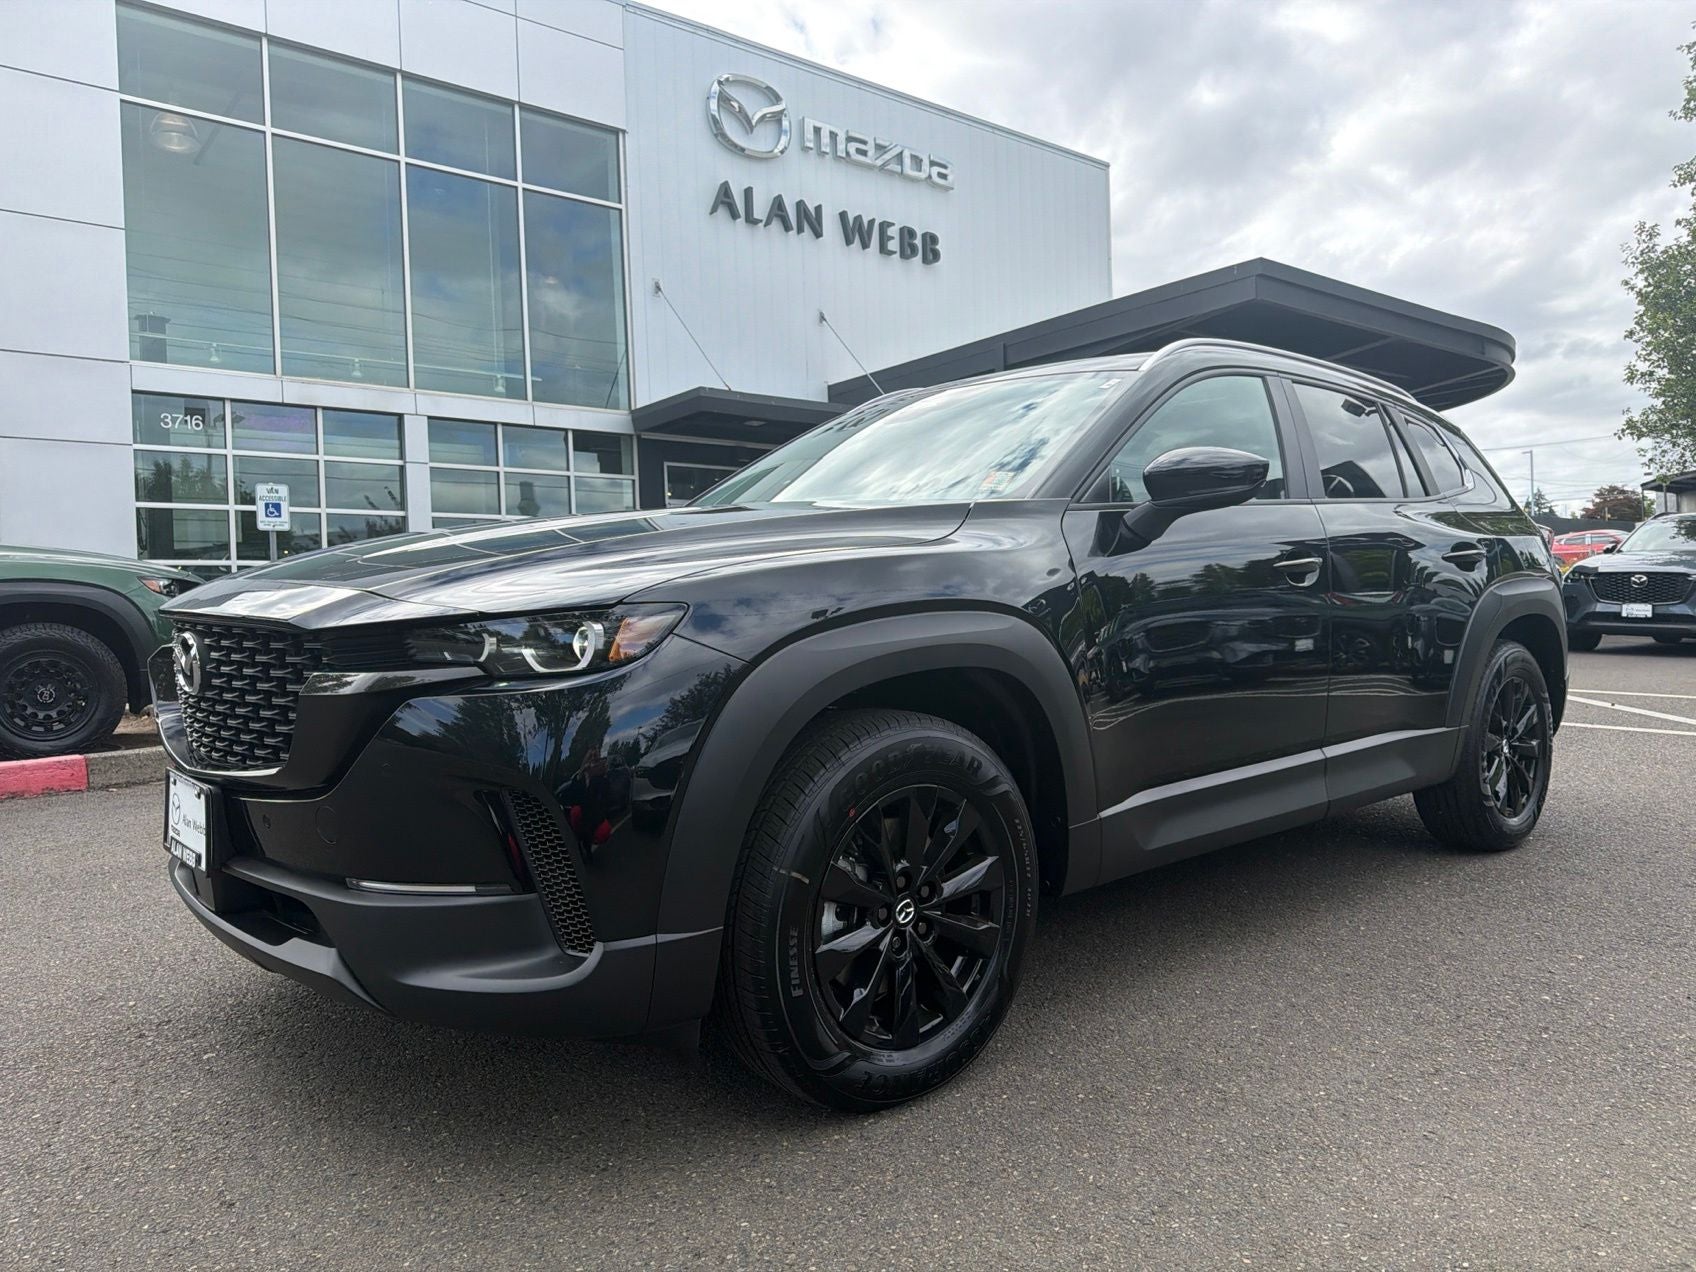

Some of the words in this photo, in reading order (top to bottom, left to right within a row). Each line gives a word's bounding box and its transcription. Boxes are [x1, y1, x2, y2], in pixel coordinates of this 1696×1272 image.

[709, 180, 824, 240] ALAN
[838, 209, 941, 266] WEBB
[160, 413, 203, 431] 3716
[266, 486, 279, 495] VAN
